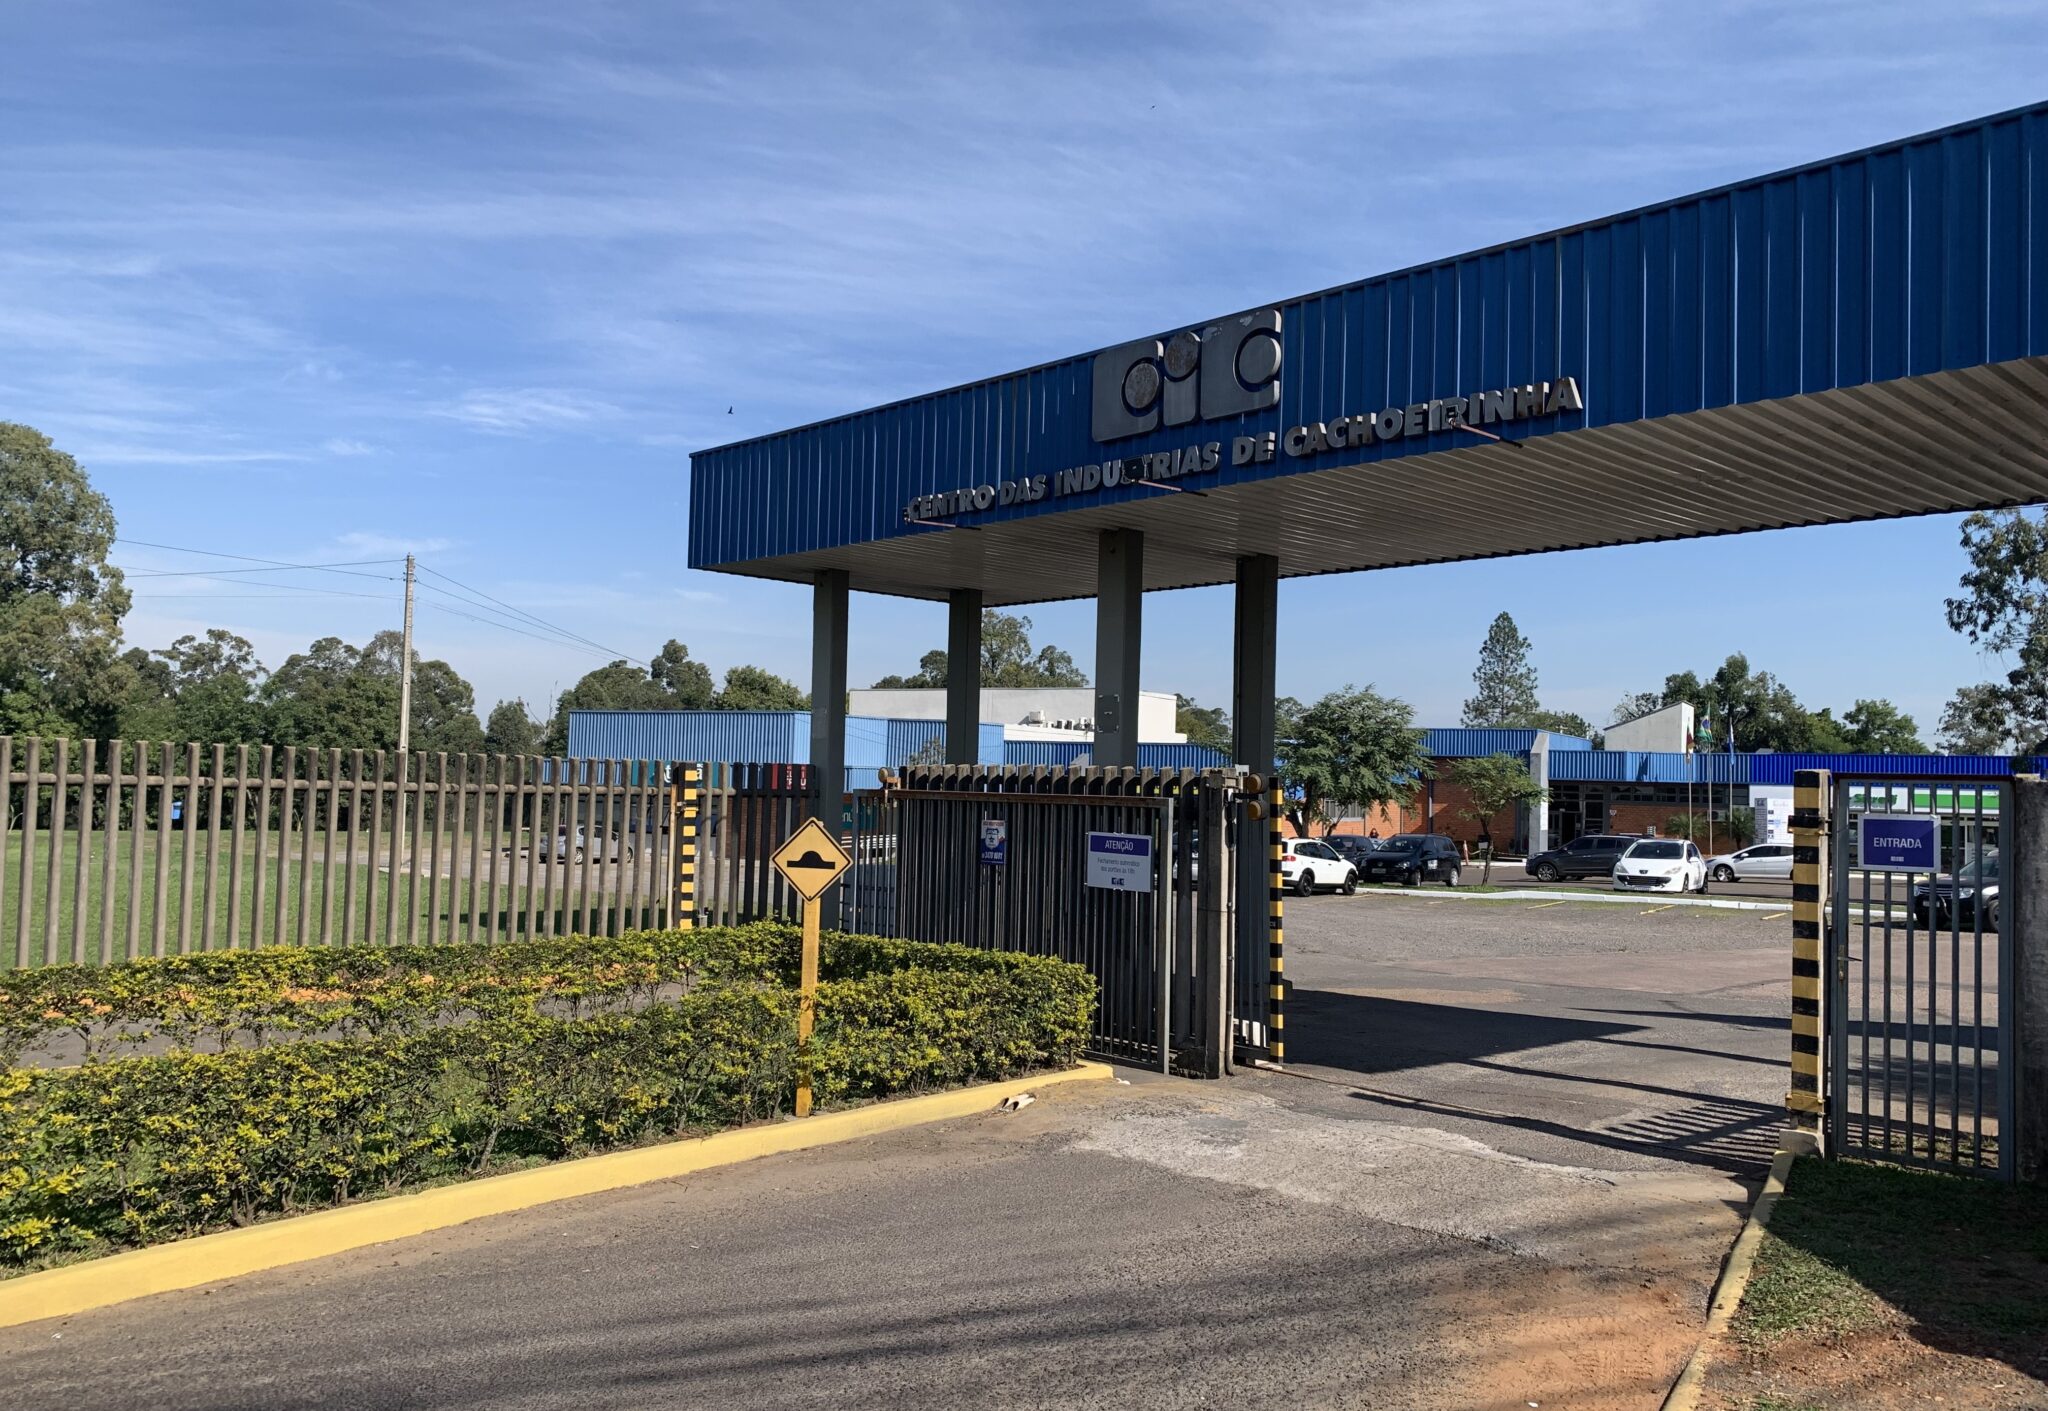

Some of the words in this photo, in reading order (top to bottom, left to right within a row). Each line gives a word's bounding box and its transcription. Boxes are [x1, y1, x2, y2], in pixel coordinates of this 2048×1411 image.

[908, 485, 996, 520] CENTRO
[999, 473, 1047, 506] DAS
[1054, 442, 1221, 497] INDURIAS
[1232, 432, 1275, 466] DE
[1284, 376, 1583, 457] CACHOEIRINHA
[1104, 840, 1134, 852] ATENÇÃO
[1873, 837, 1922, 849] ENTRADA
